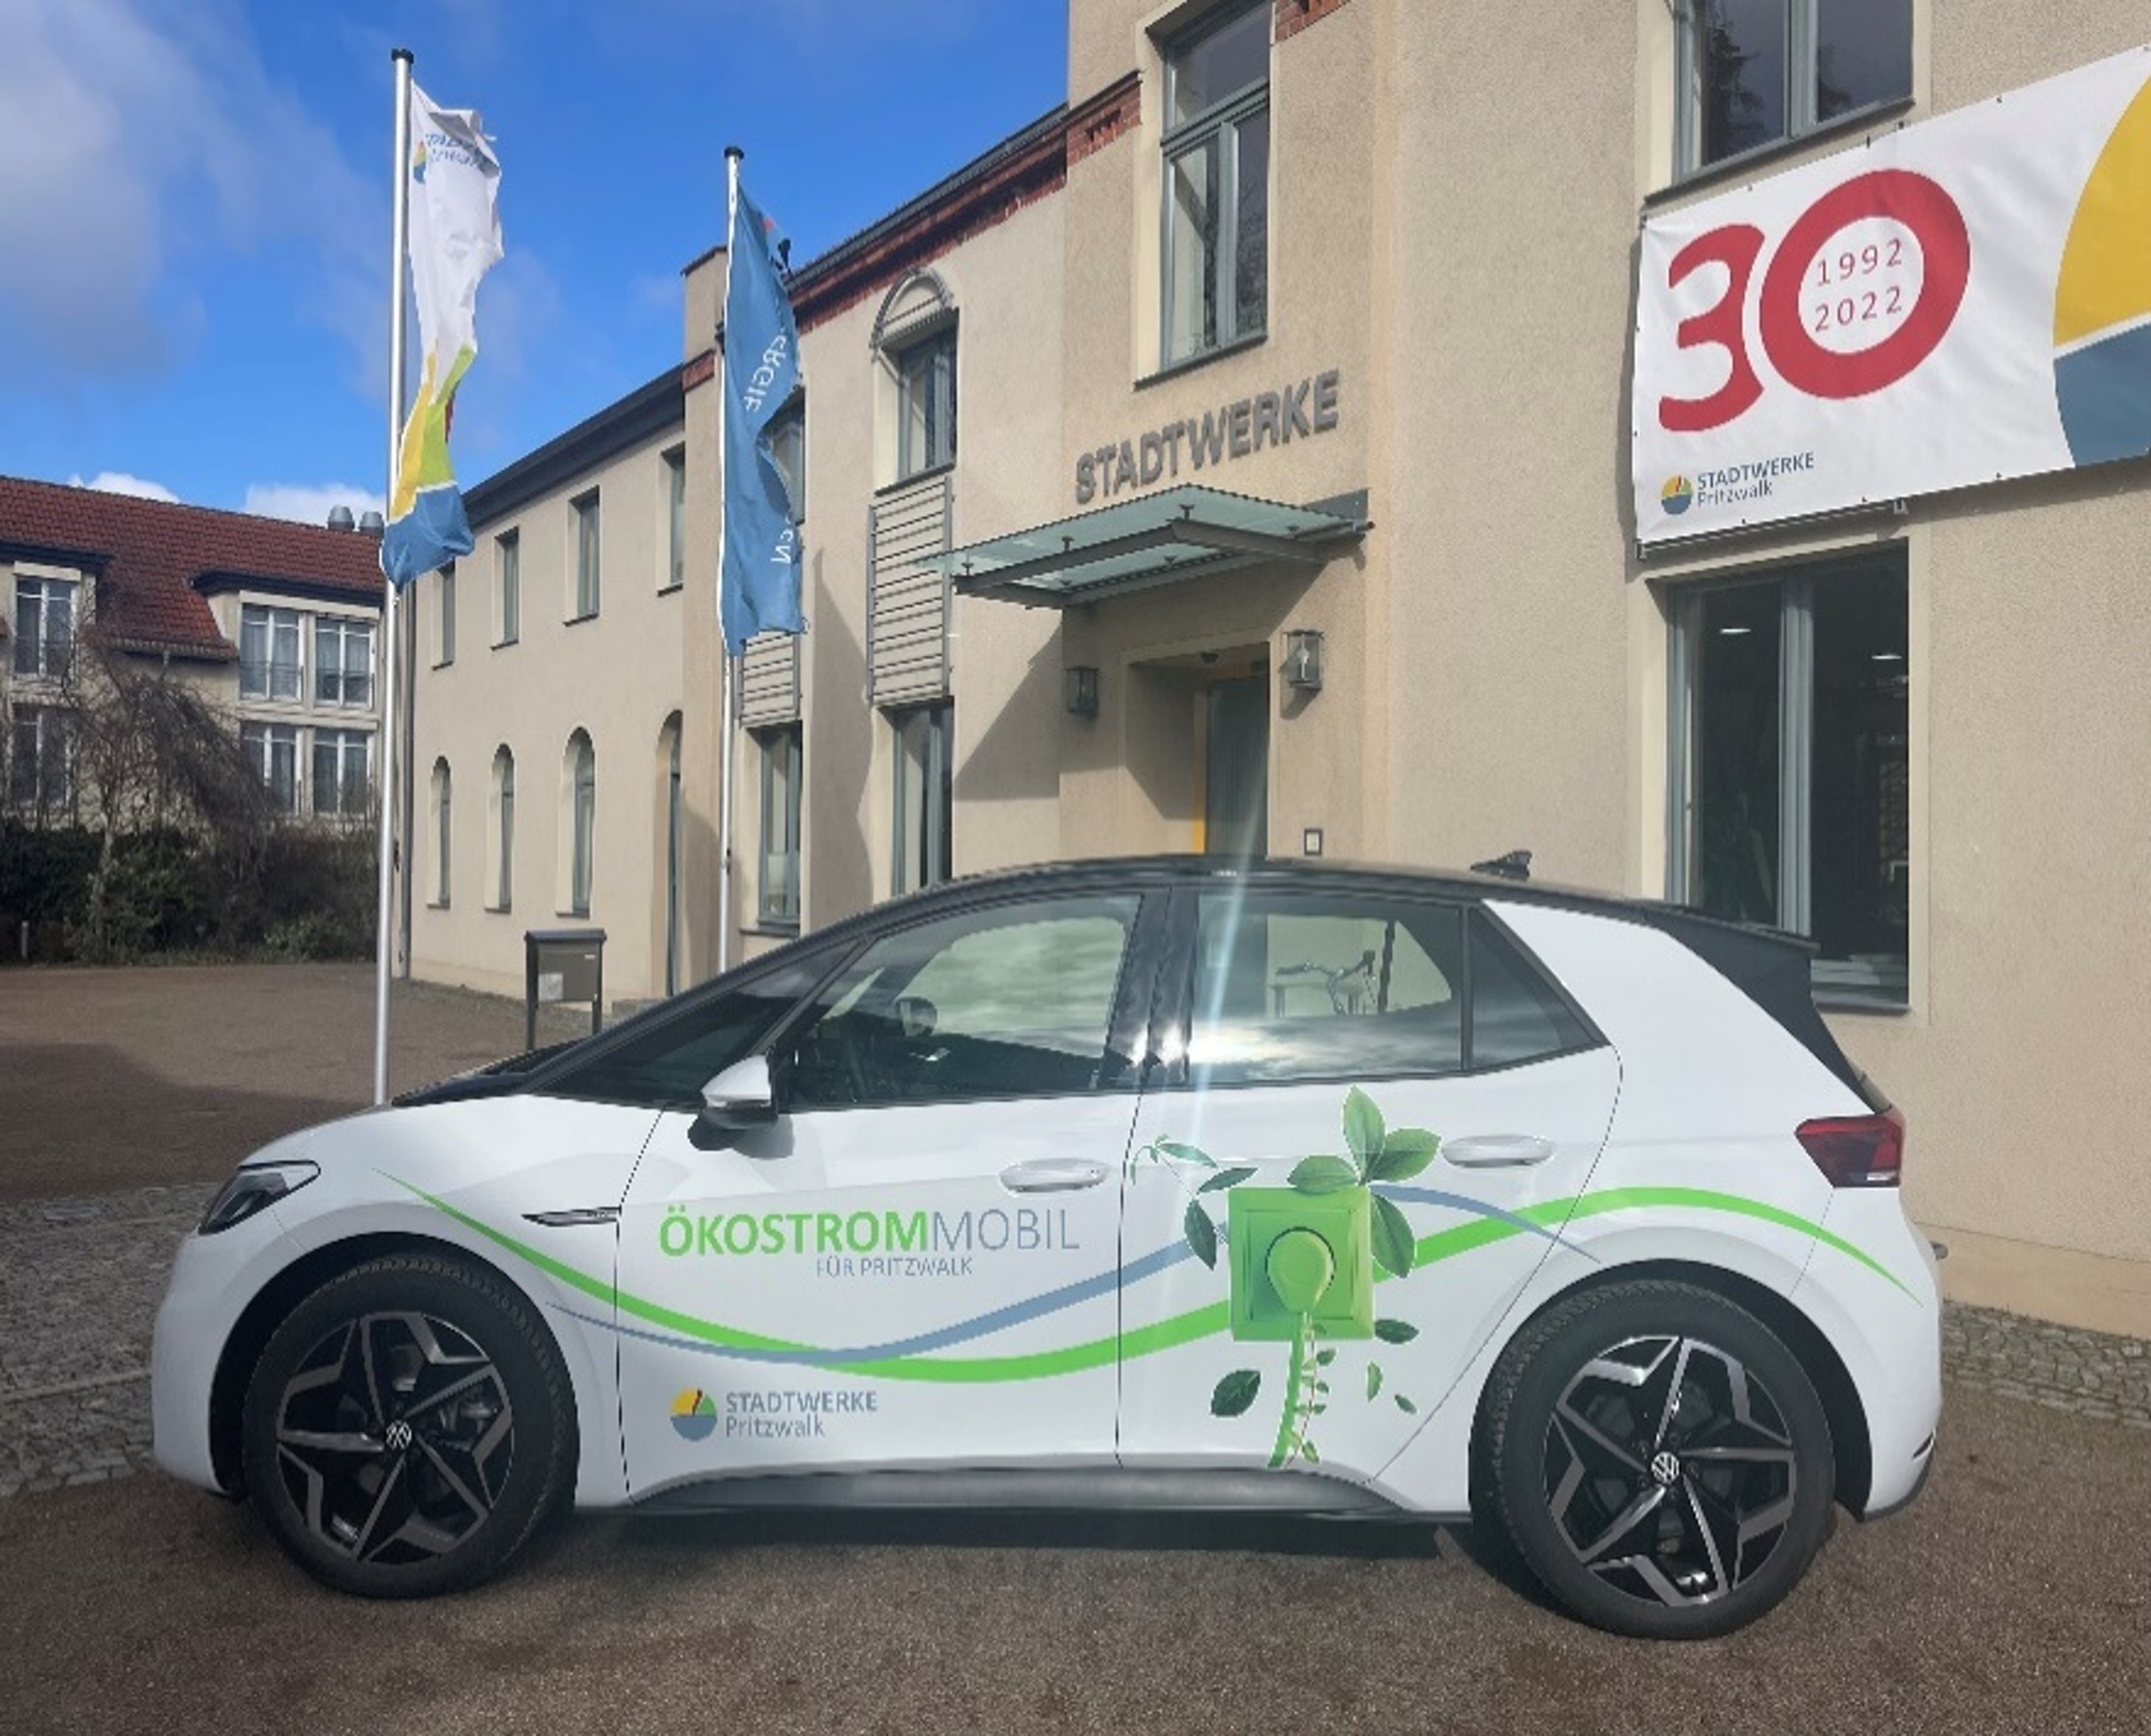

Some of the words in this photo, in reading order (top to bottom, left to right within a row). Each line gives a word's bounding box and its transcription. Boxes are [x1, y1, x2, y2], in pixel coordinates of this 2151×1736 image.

[1817, 238, 1902, 287] 1992
[1659, 169, 1970, 432] 30
[1815, 286, 1902, 332] 2022
[1076, 368, 1339, 505] STADTWERKE
[1698, 452, 1815, 490] STADTWERKE
[1698, 480, 1773, 507] Pritzwalk
[659, 1205, 1079, 1255] ÖKOSTROMMOBIL
[817, 1255, 854, 1277] FÜR
[860, 1257, 972, 1277] PRITZWALK
[726, 1391, 877, 1414] STADTWERKE
[726, 1415, 825, 1438] Pritzwalk
